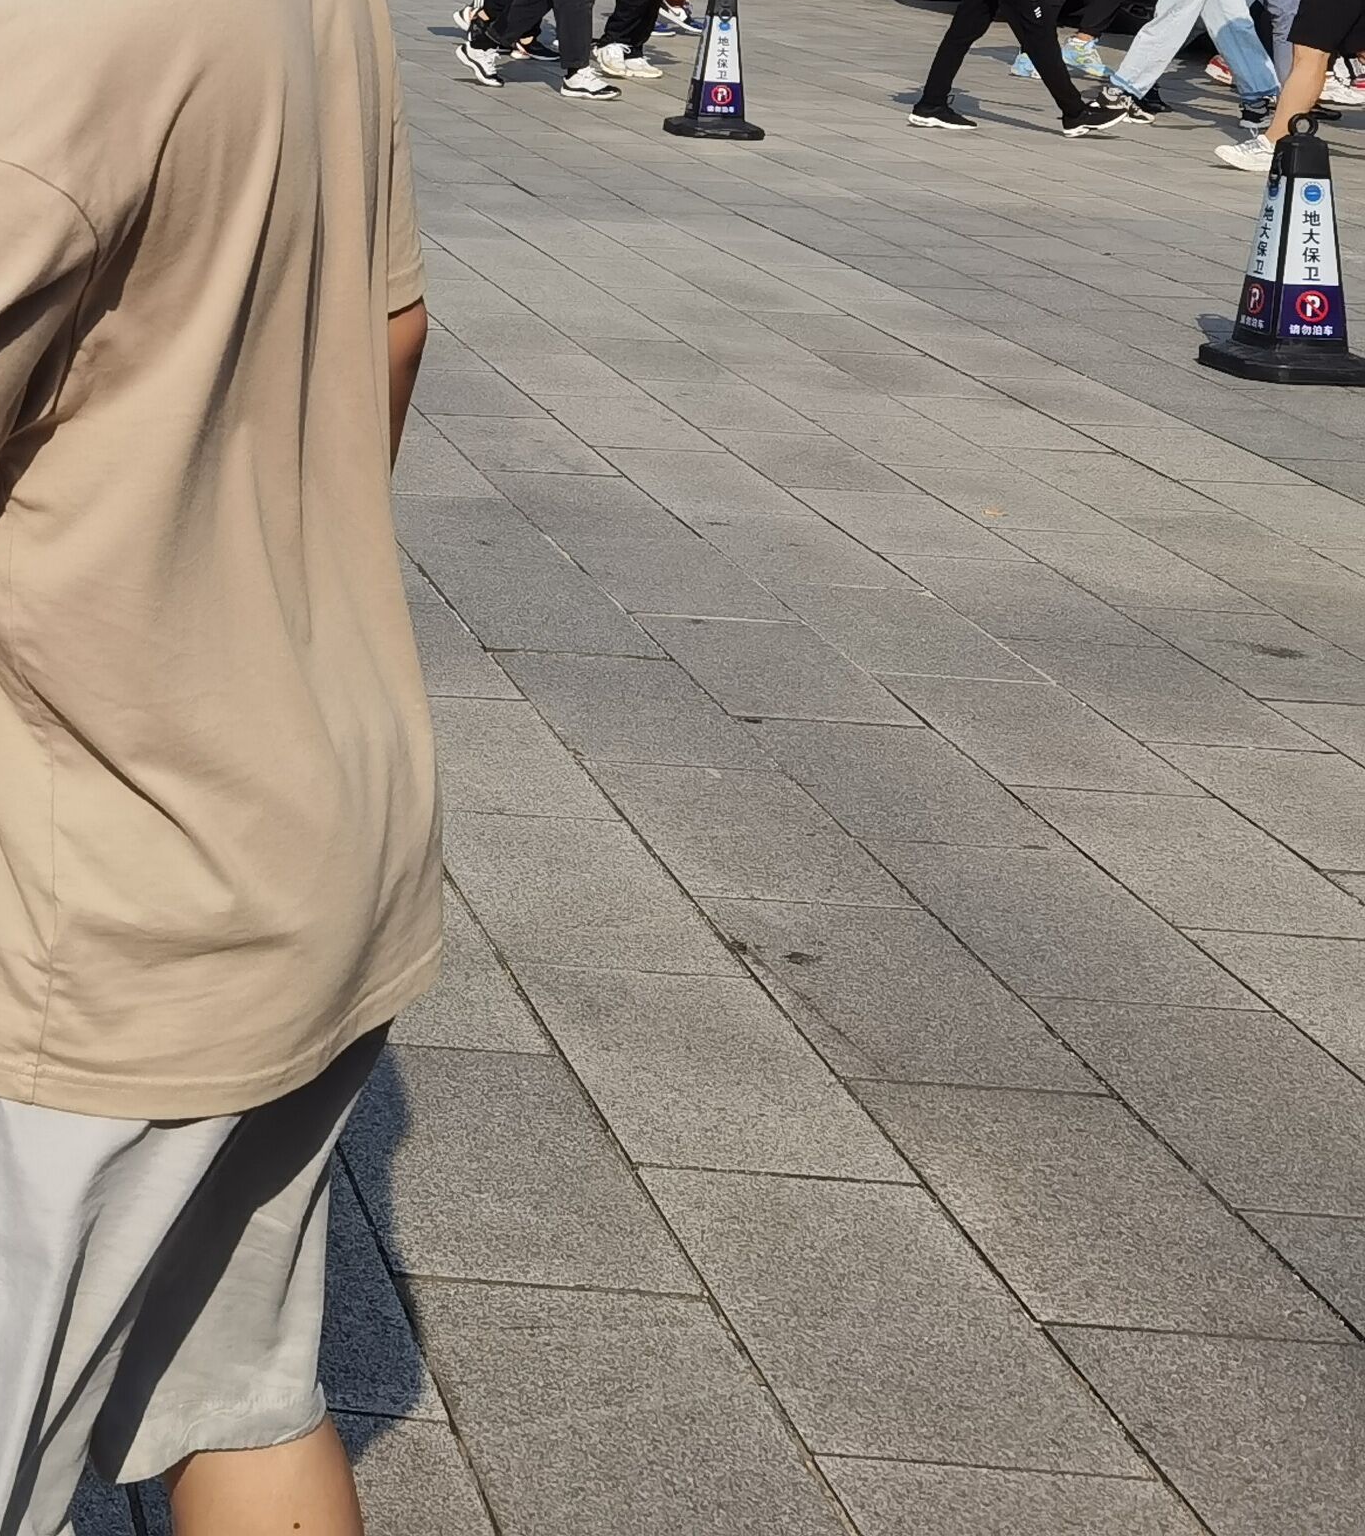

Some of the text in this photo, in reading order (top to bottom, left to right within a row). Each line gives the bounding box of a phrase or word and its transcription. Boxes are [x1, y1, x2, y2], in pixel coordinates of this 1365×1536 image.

[716, 36, 730, 80] 地大保卫
[1302, 210, 1321, 282] 地大保卫
[1289, 324, 1334, 336] 请勿泊车
